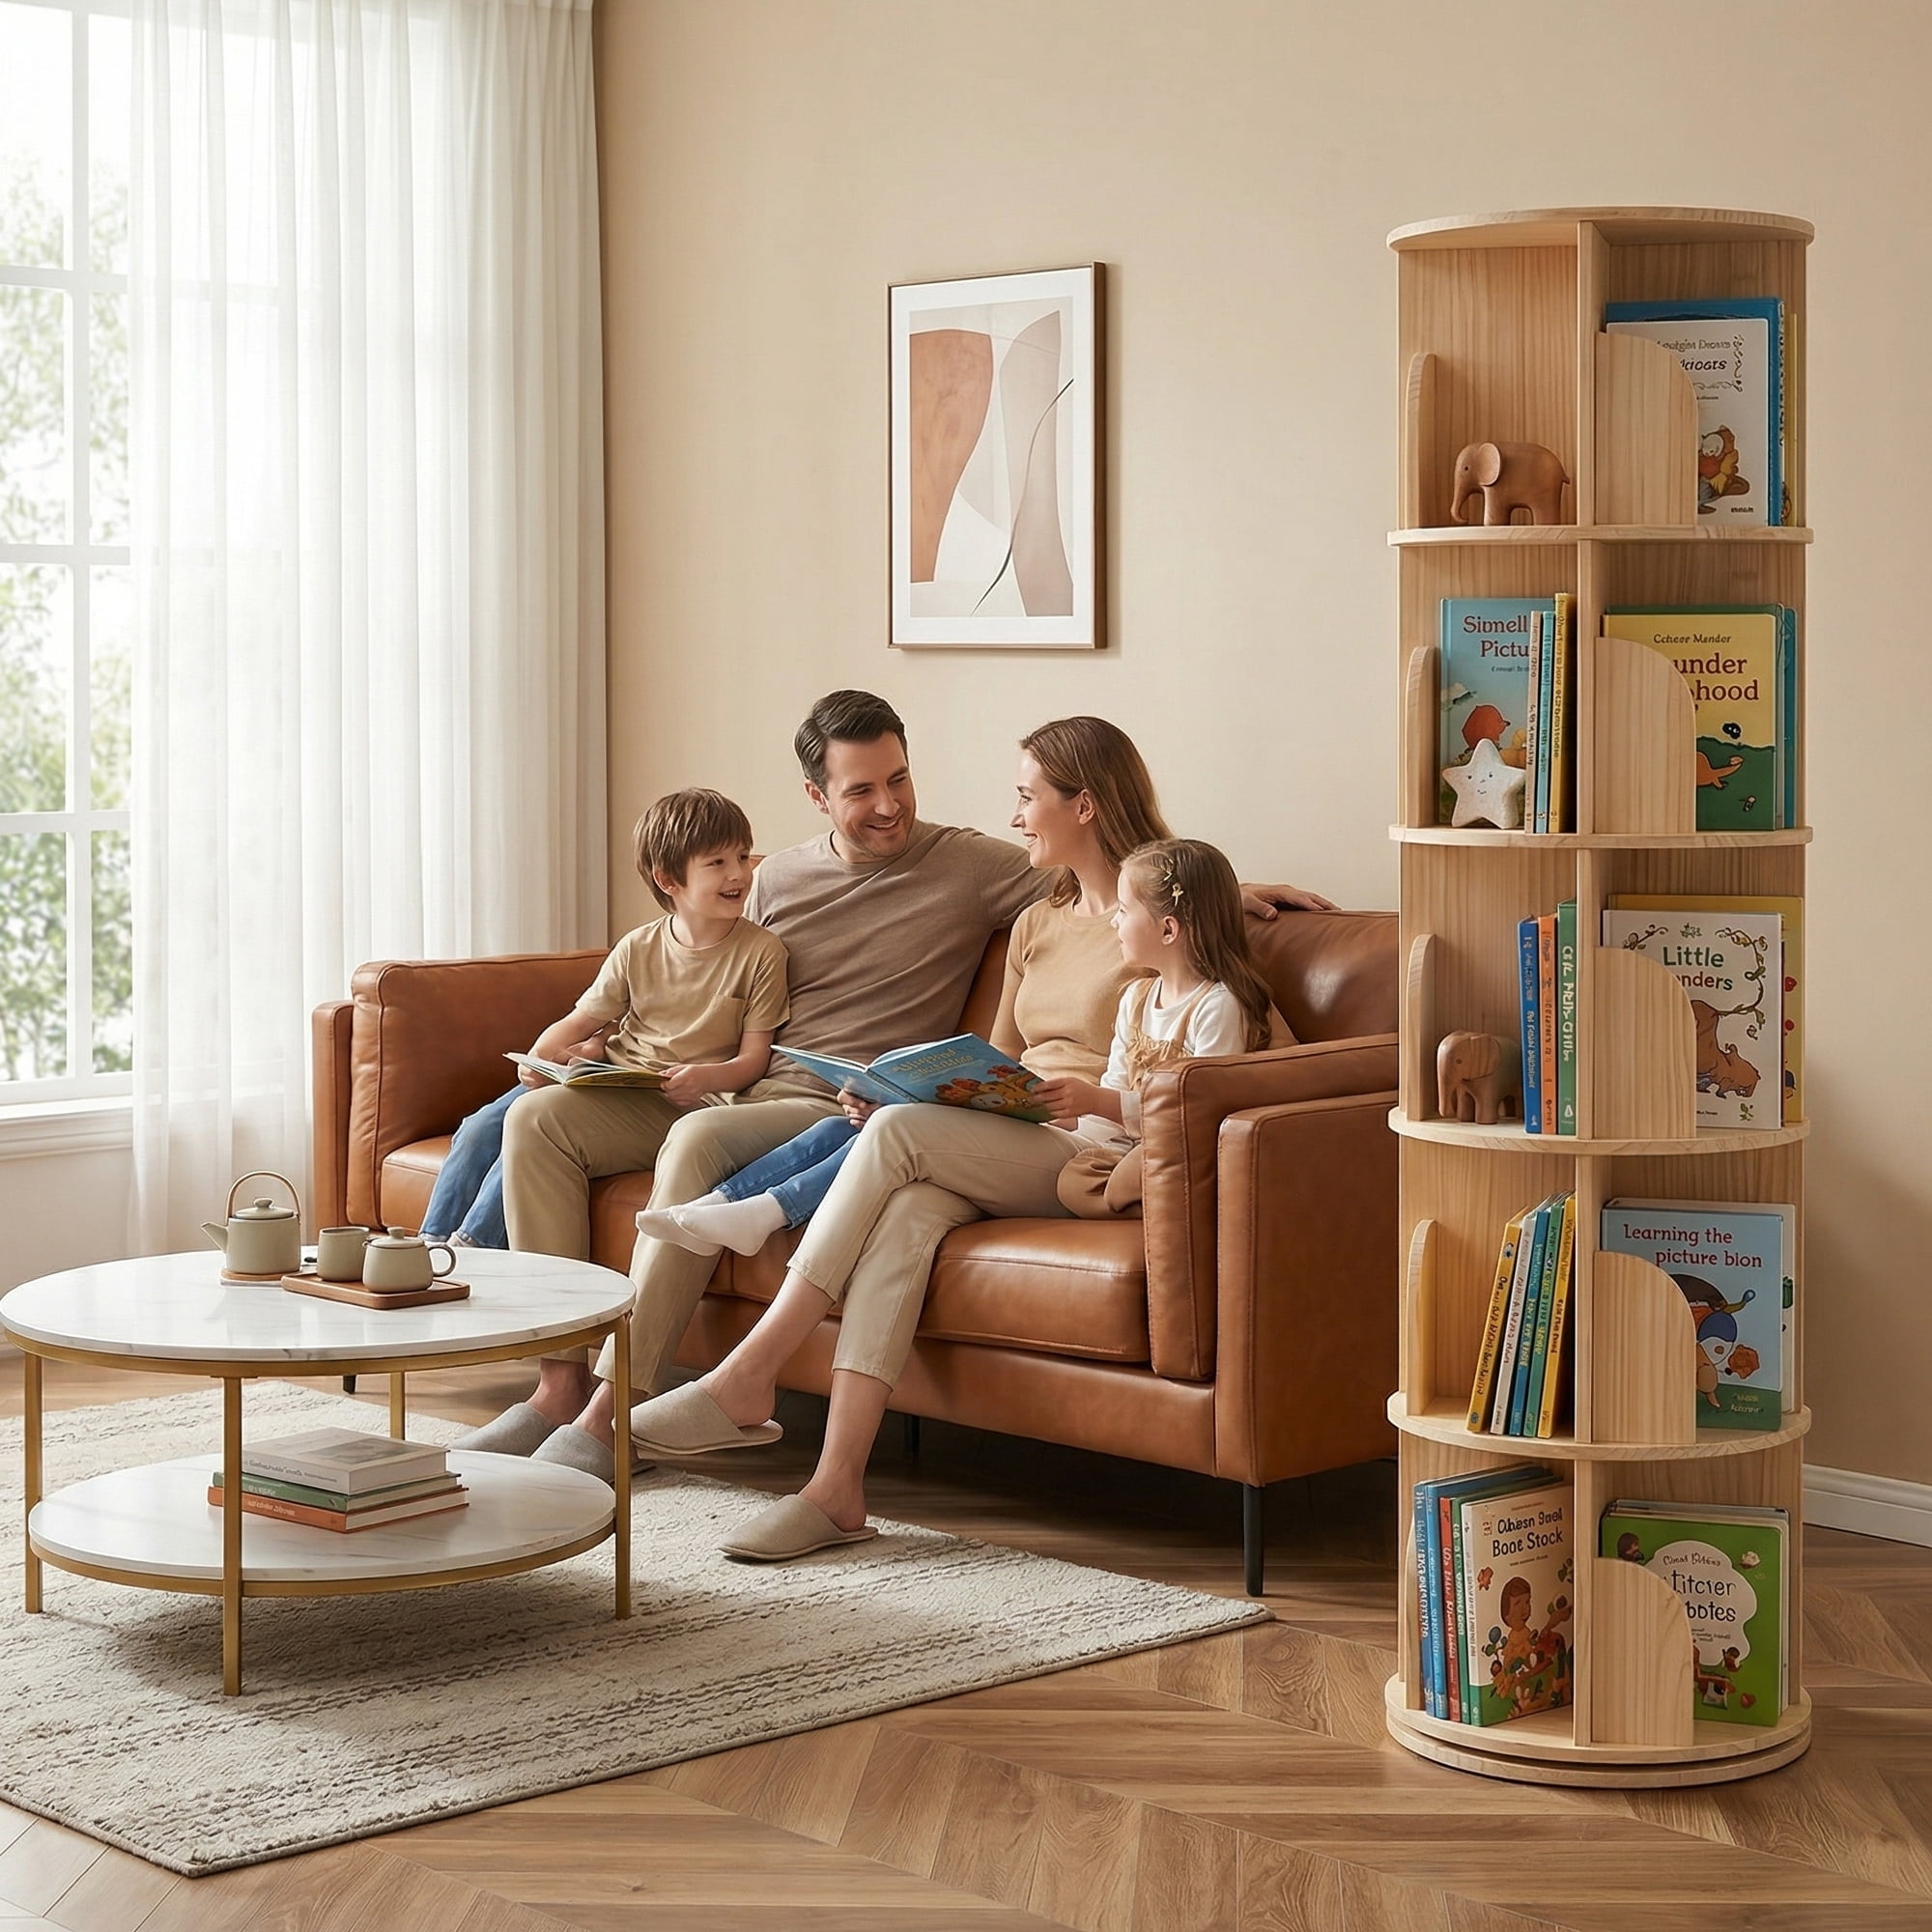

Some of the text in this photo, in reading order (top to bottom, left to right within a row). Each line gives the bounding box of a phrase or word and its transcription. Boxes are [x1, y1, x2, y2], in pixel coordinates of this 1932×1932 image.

[1690, 679, 1759, 701] hood
[1662, 946, 1724, 968] Little
[1676, 971, 1733, 991] nders
[1623, 1223, 1733, 1247] Learning the
[1655, 1248, 1718, 1267] picture
[1526, 1526, 1563, 1550] Stock
